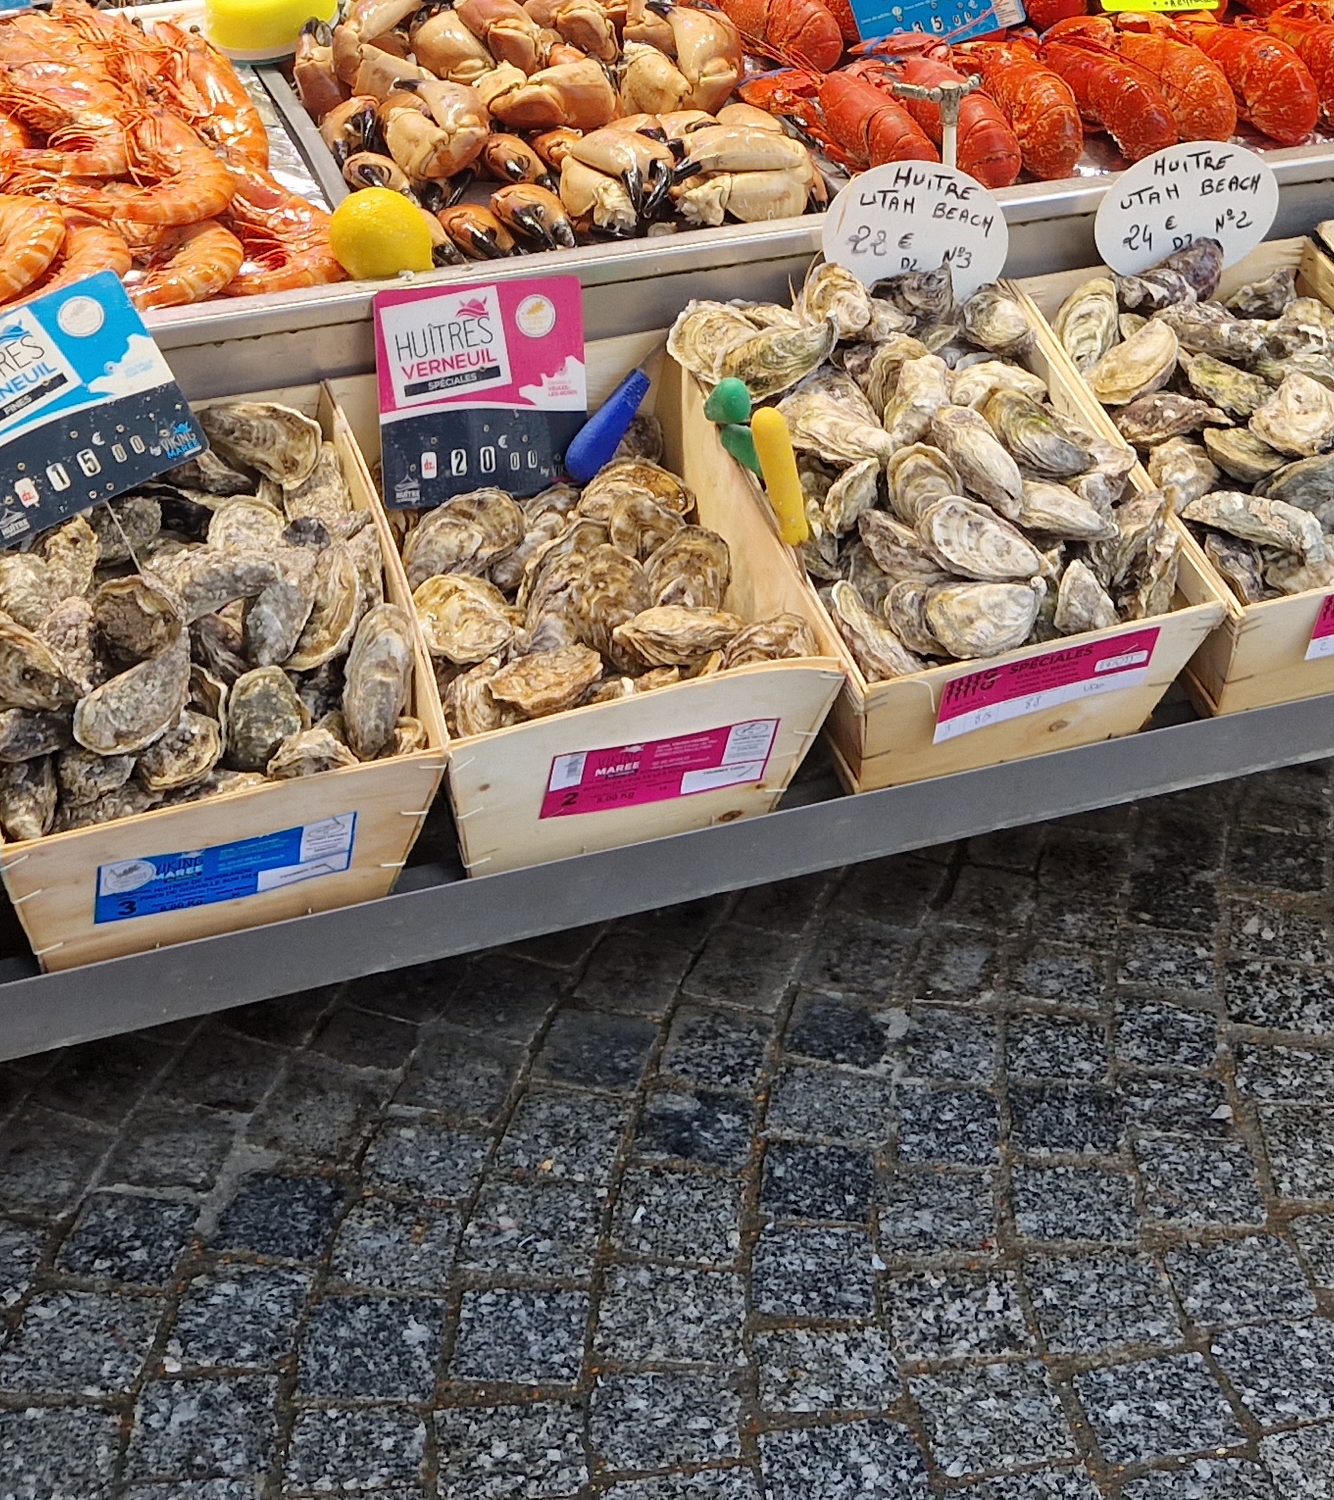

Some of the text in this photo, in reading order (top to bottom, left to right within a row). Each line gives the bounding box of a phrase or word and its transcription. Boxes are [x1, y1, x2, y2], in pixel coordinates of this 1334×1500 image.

[1154, 150, 1234, 176] HUITRE
[893, 166, 979, 201] HUITRE
[1120, 173, 1262, 210] UTAH BEACH
[860, 190, 995, 238] UTAH BEACH
[898, 232, 914, 250] €
[1123, 224, 1153, 251] 24
[1165, 215, 1178, 230] €
[395, 316, 494, 362] HUÎTRES
[401, 348, 498, 380] VERNEUIL
[427, 372, 478, 391] SPÉCIALES
[3, 395, 33, 416] FINES
[498, 435, 508, 448] €
[1009, 645, 1094, 675] SPÉCIALES
[595, 761, 640, 777] MAREE
[561, 792, 579, 806] 2
[152, 864, 204, 881] MAREE
[118, 901, 137, 915] 3
